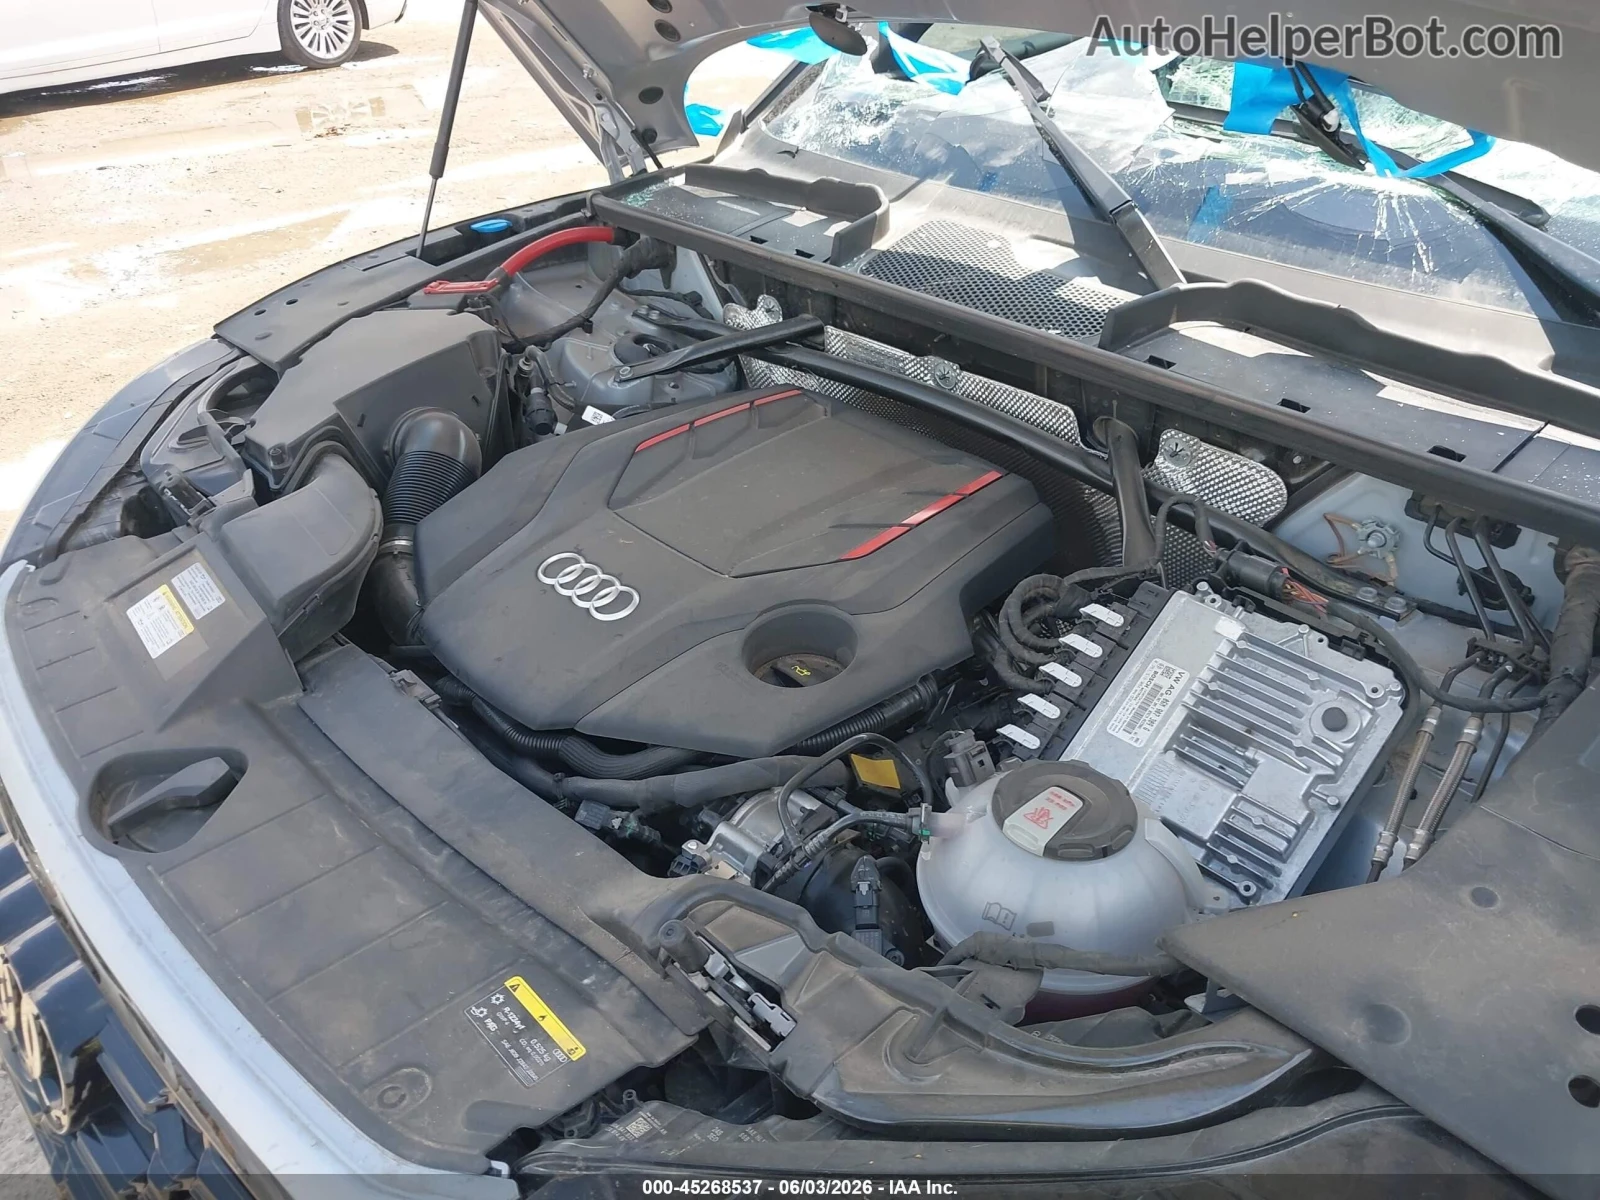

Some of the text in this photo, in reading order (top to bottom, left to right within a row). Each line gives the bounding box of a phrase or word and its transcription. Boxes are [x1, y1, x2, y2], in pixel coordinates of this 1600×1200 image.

[1144, 670, 1159, 689] BOSCH
[1173, 671, 1185, 684] VW
[1165, 684, 1175, 696] AG
[484, 1018, 498, 1032] PAG
[543, 1052, 551, 1062] kg
